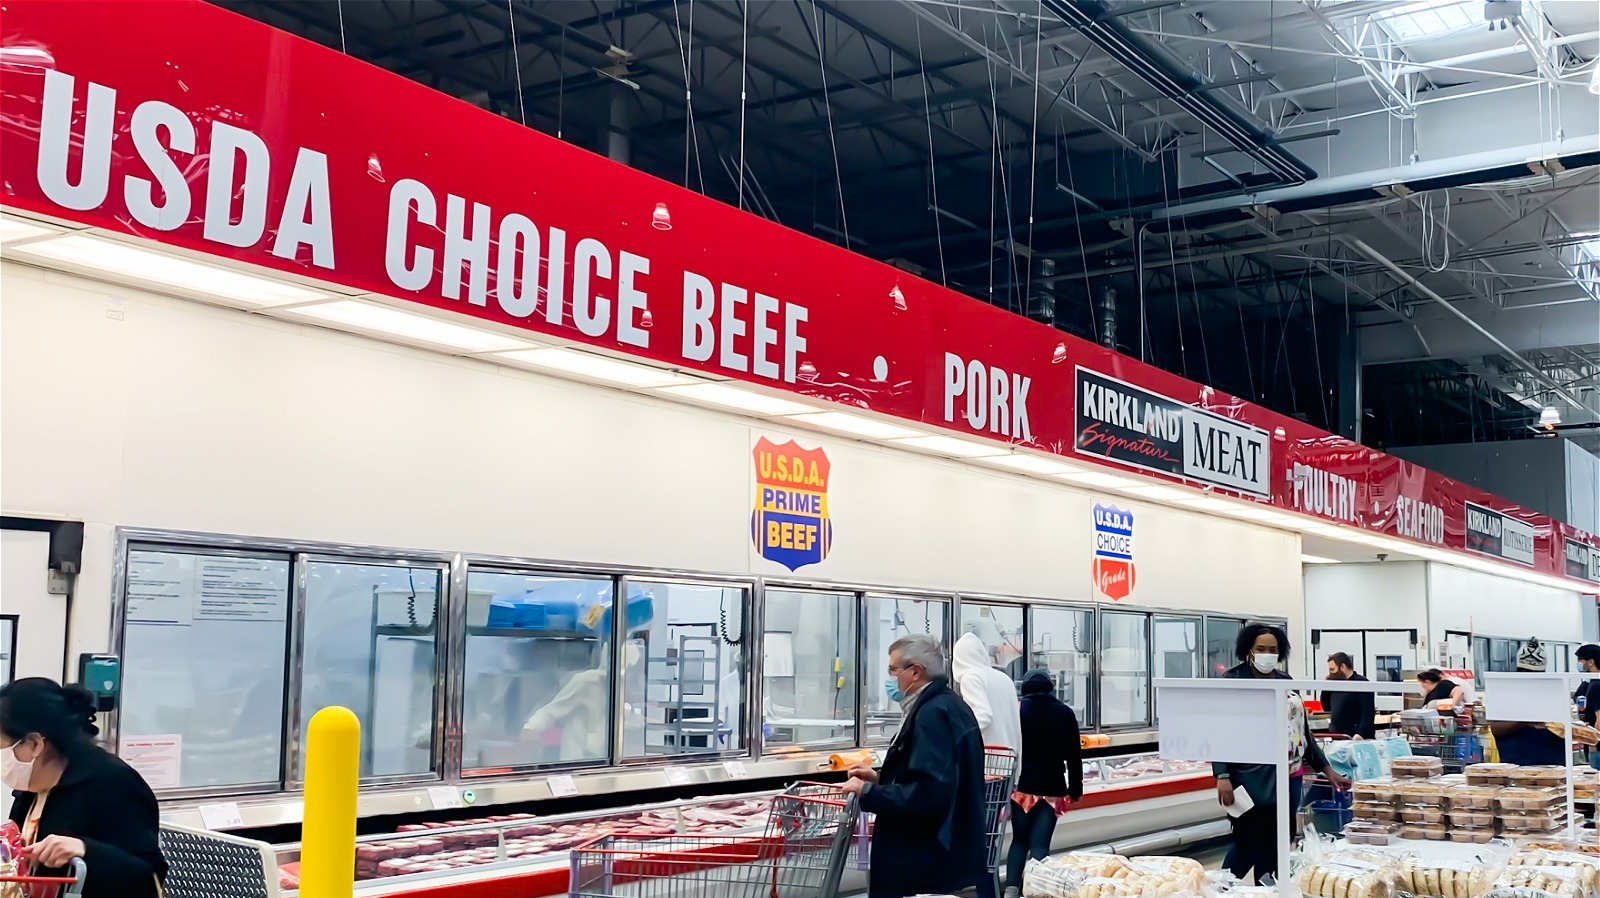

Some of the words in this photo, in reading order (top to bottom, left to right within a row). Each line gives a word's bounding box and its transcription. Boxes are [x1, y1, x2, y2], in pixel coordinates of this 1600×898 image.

[37, 68, 335, 270] USDA
[385, 178, 650, 349] CHOICE
[682, 270, 808, 384] BEEF
[944, 351, 1032, 440] PORK
[1083, 380, 1181, 443] KIRKLAND
[1081, 422, 1180, 463] Signature
[1192, 421, 1261, 483] MEAT
[760, 450, 825, 487] U.S.D.A.
[763, 487, 821, 514] PRIME
[1293, 462, 1357, 522] POULTRY
[767, 520, 817, 550] BEEF
[1096, 509, 1132, 531] U.S.D.A.
[1396, 494, 1444, 544] SEAFOOD
[1467, 508, 1501, 538] KIRKLAND
[1097, 533, 1130, 553] CHOICE
[1101, 567, 1126, 593] Grade
